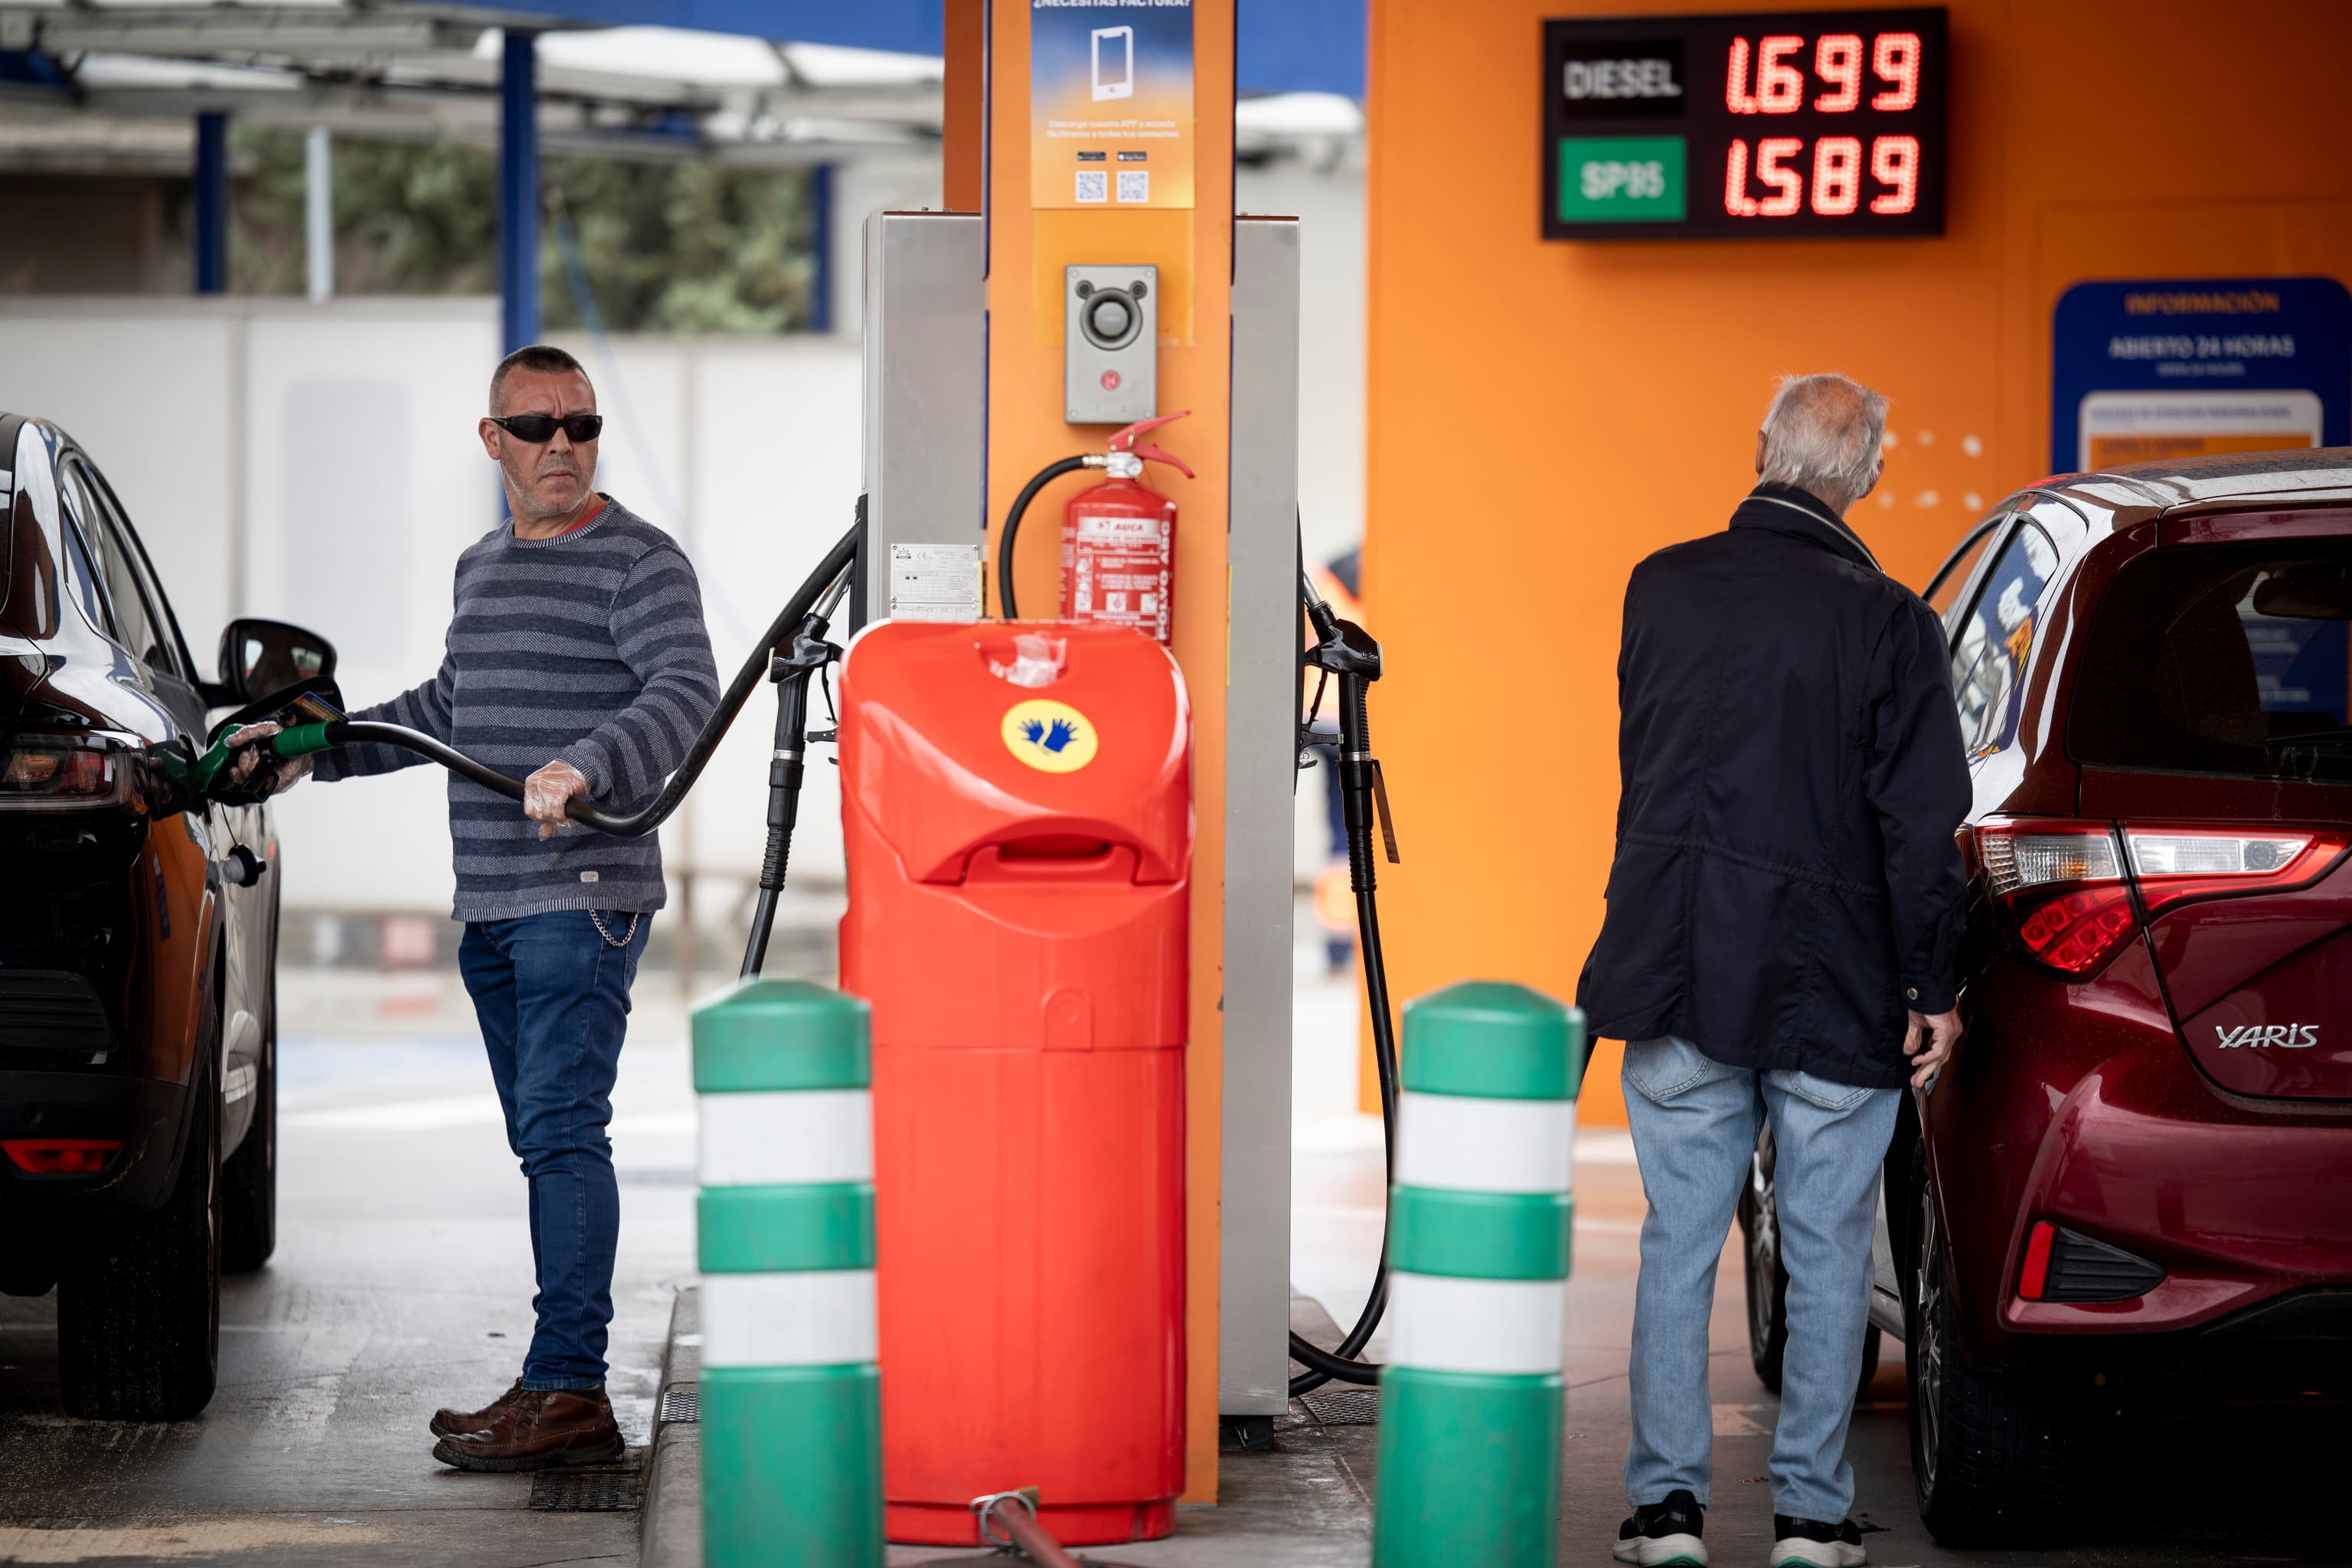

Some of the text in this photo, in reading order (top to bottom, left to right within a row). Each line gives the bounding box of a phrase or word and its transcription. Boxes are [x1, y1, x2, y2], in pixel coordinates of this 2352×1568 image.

[1563, 59, 1682, 99] DIESEL
[1726, 33, 1921, 113] 1.699
[1725, 136, 1919, 216] 1.589
[2125, 290, 2280, 315] INFORMACIÓN
[2109, 335, 2295, 359] ABIERTO 24 HORAS
